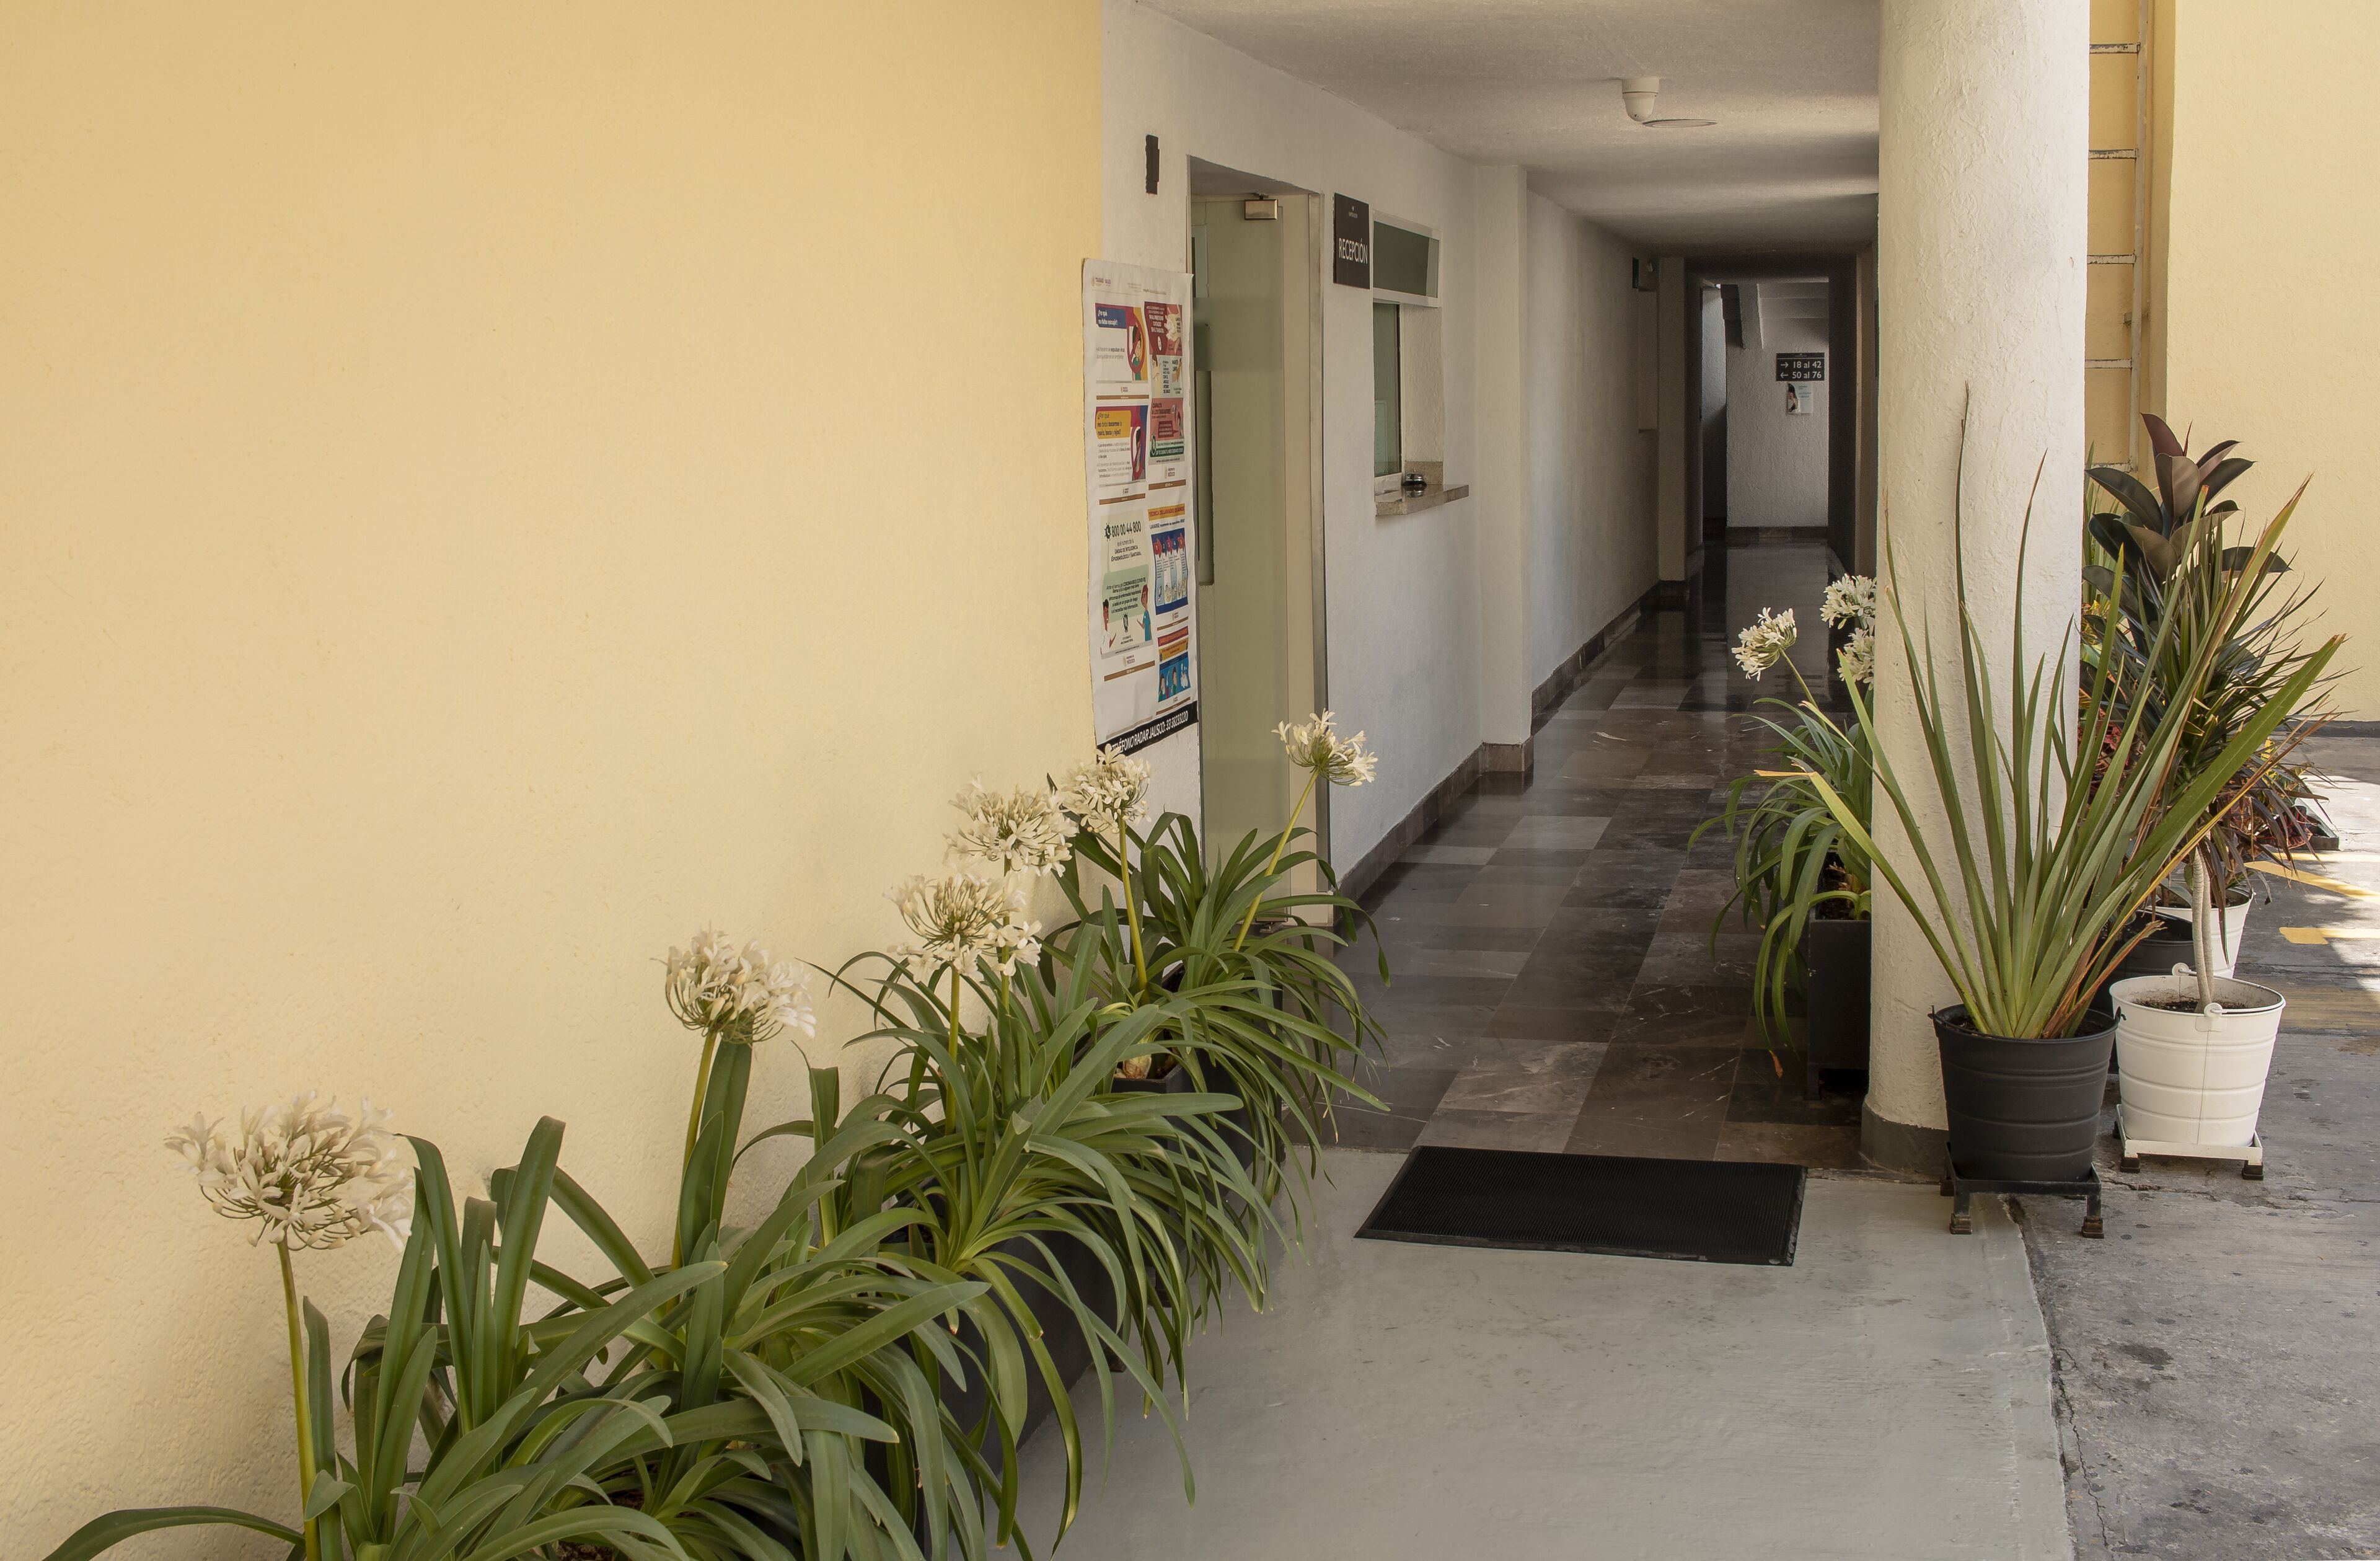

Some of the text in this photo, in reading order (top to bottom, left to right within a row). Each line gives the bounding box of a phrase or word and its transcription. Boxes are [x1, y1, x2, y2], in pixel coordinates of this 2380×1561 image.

[1339, 238, 1367, 264] RECEPCIÓN
[1120, 523, 1126, 535] 00
[1126, 523, 1132, 534] 44
[1133, 521, 1141, 533] 800
[1134, 730, 1148, 745] RADAR
[1166, 720, 1171, 731] 33
